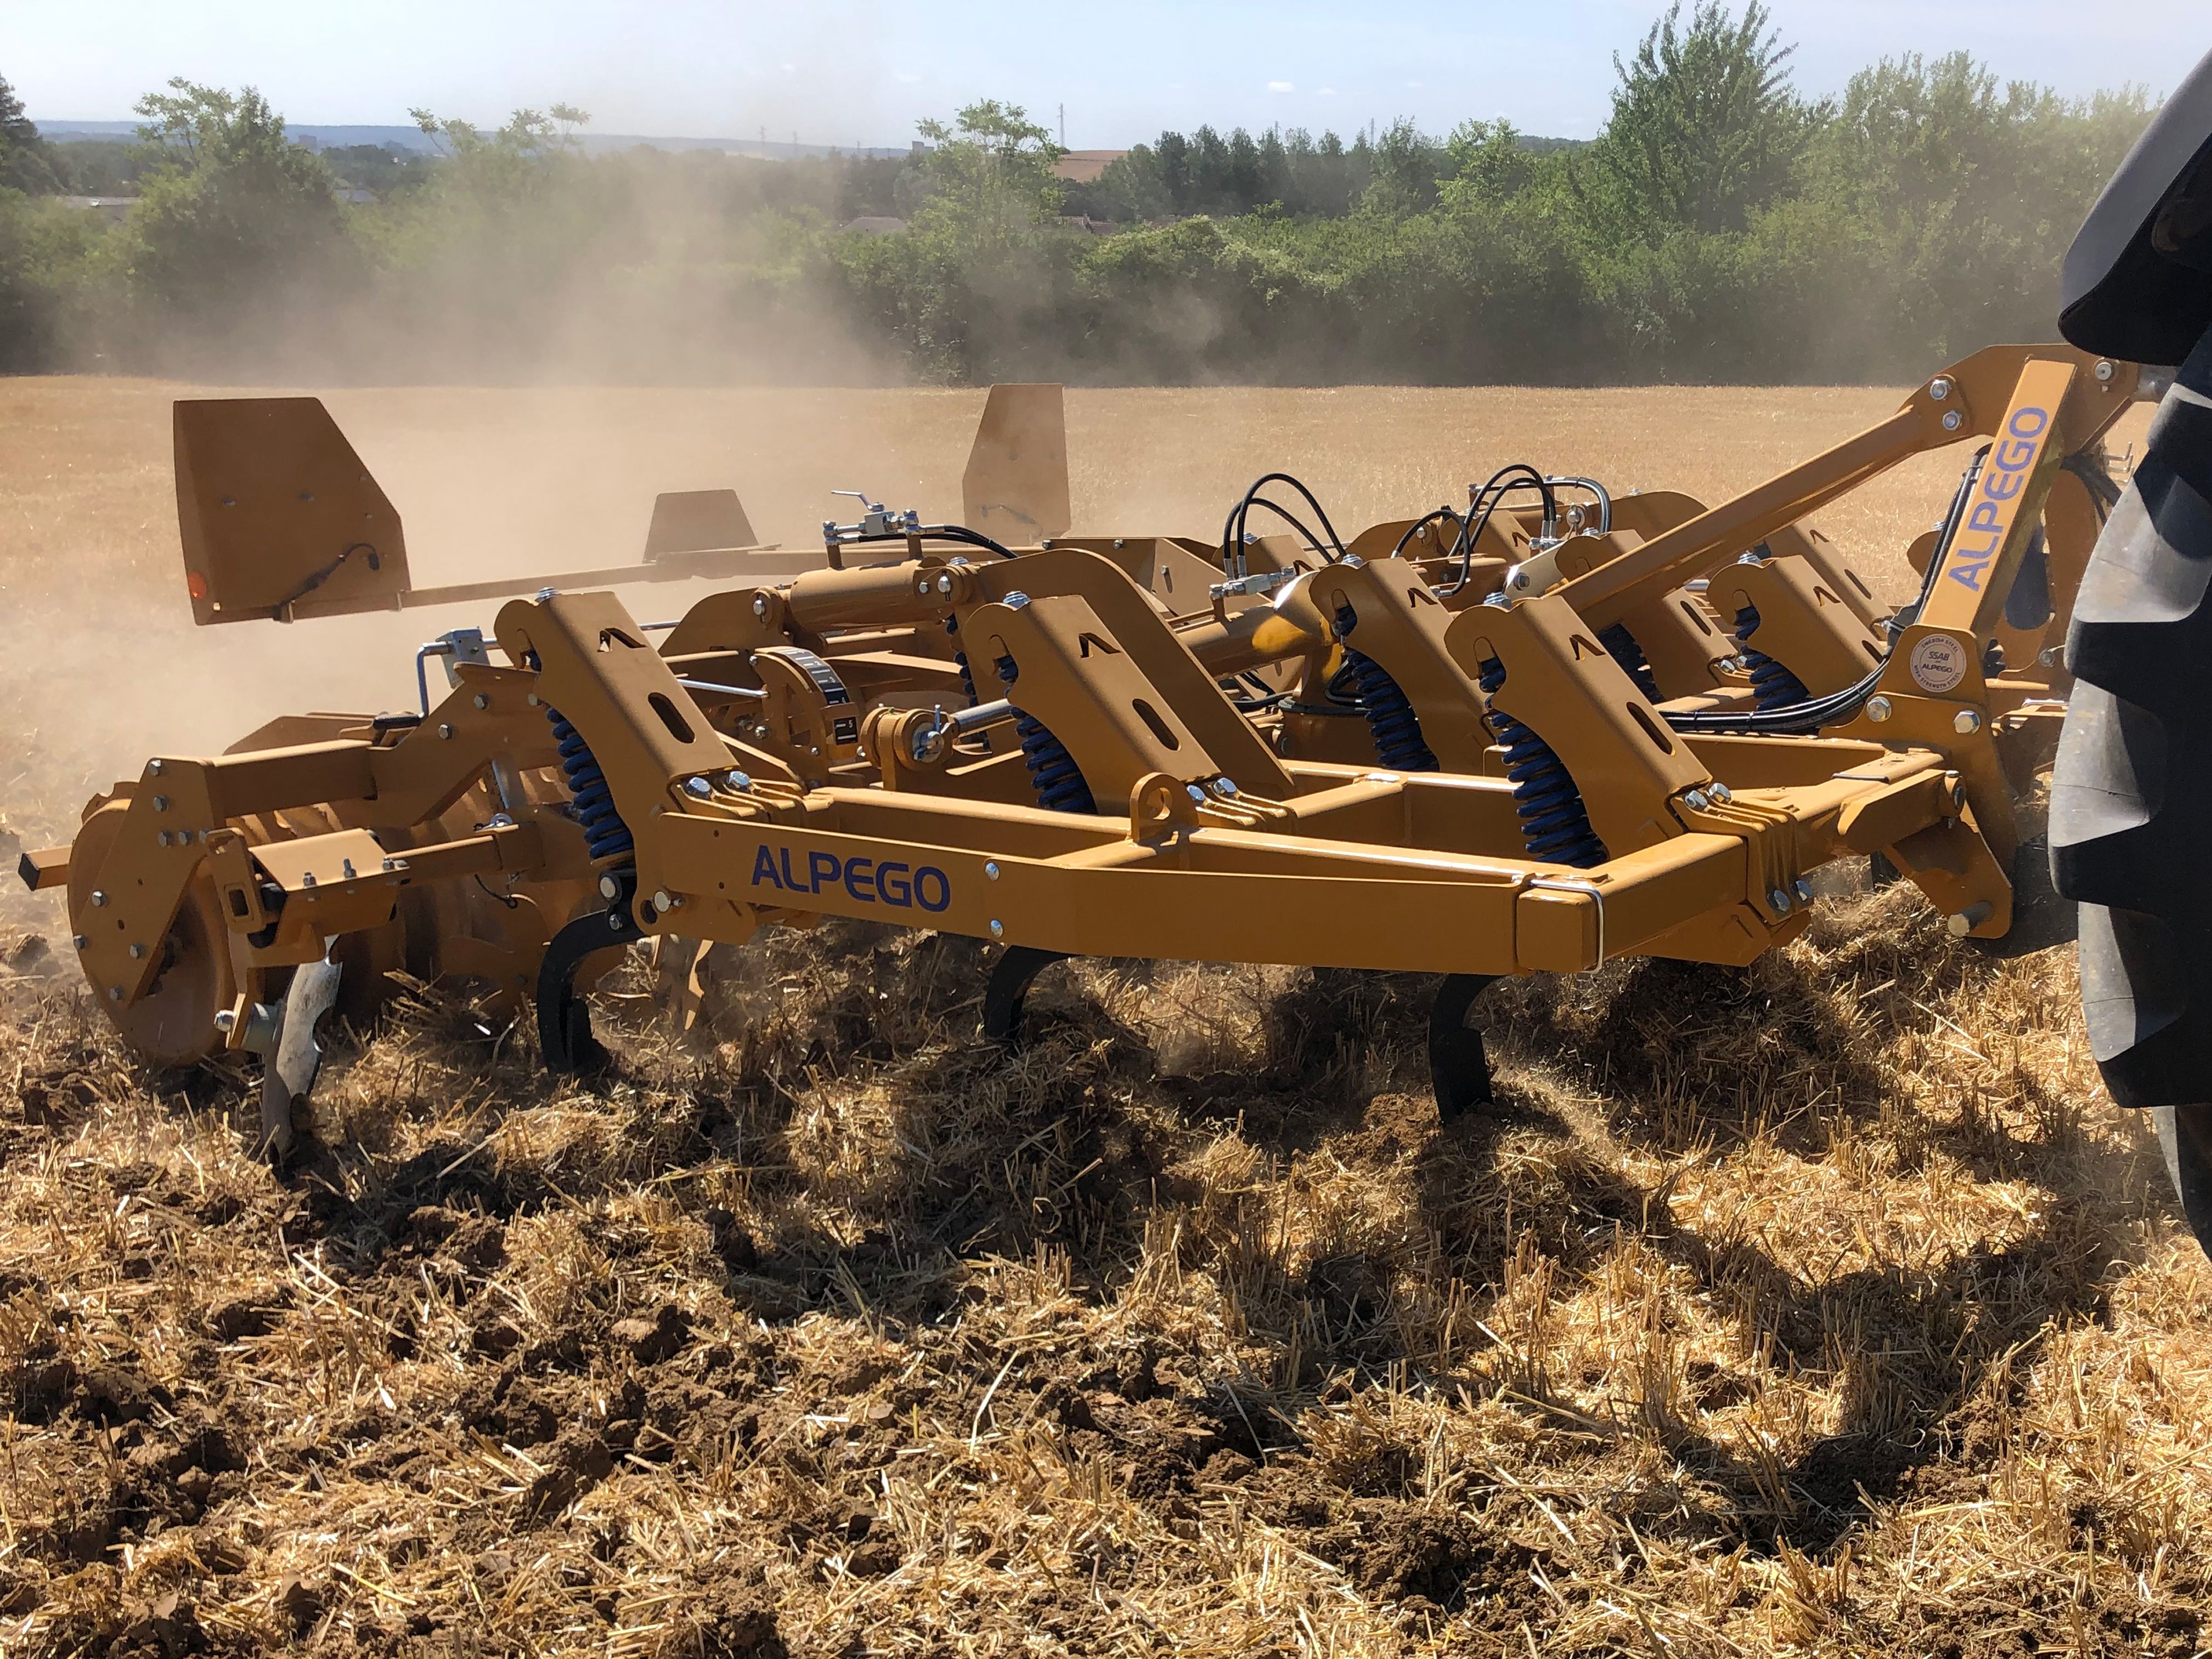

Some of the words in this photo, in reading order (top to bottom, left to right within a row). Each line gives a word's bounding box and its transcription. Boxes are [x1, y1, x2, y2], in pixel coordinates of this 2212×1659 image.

[1949, 407, 2047, 592] ALPEGO
[1928, 651, 1950, 661] SSAB
[1922, 663, 1953, 673] ALPEGO
[848, 720, 853, 728] 5
[751, 845, 950, 912] ALPEGO
